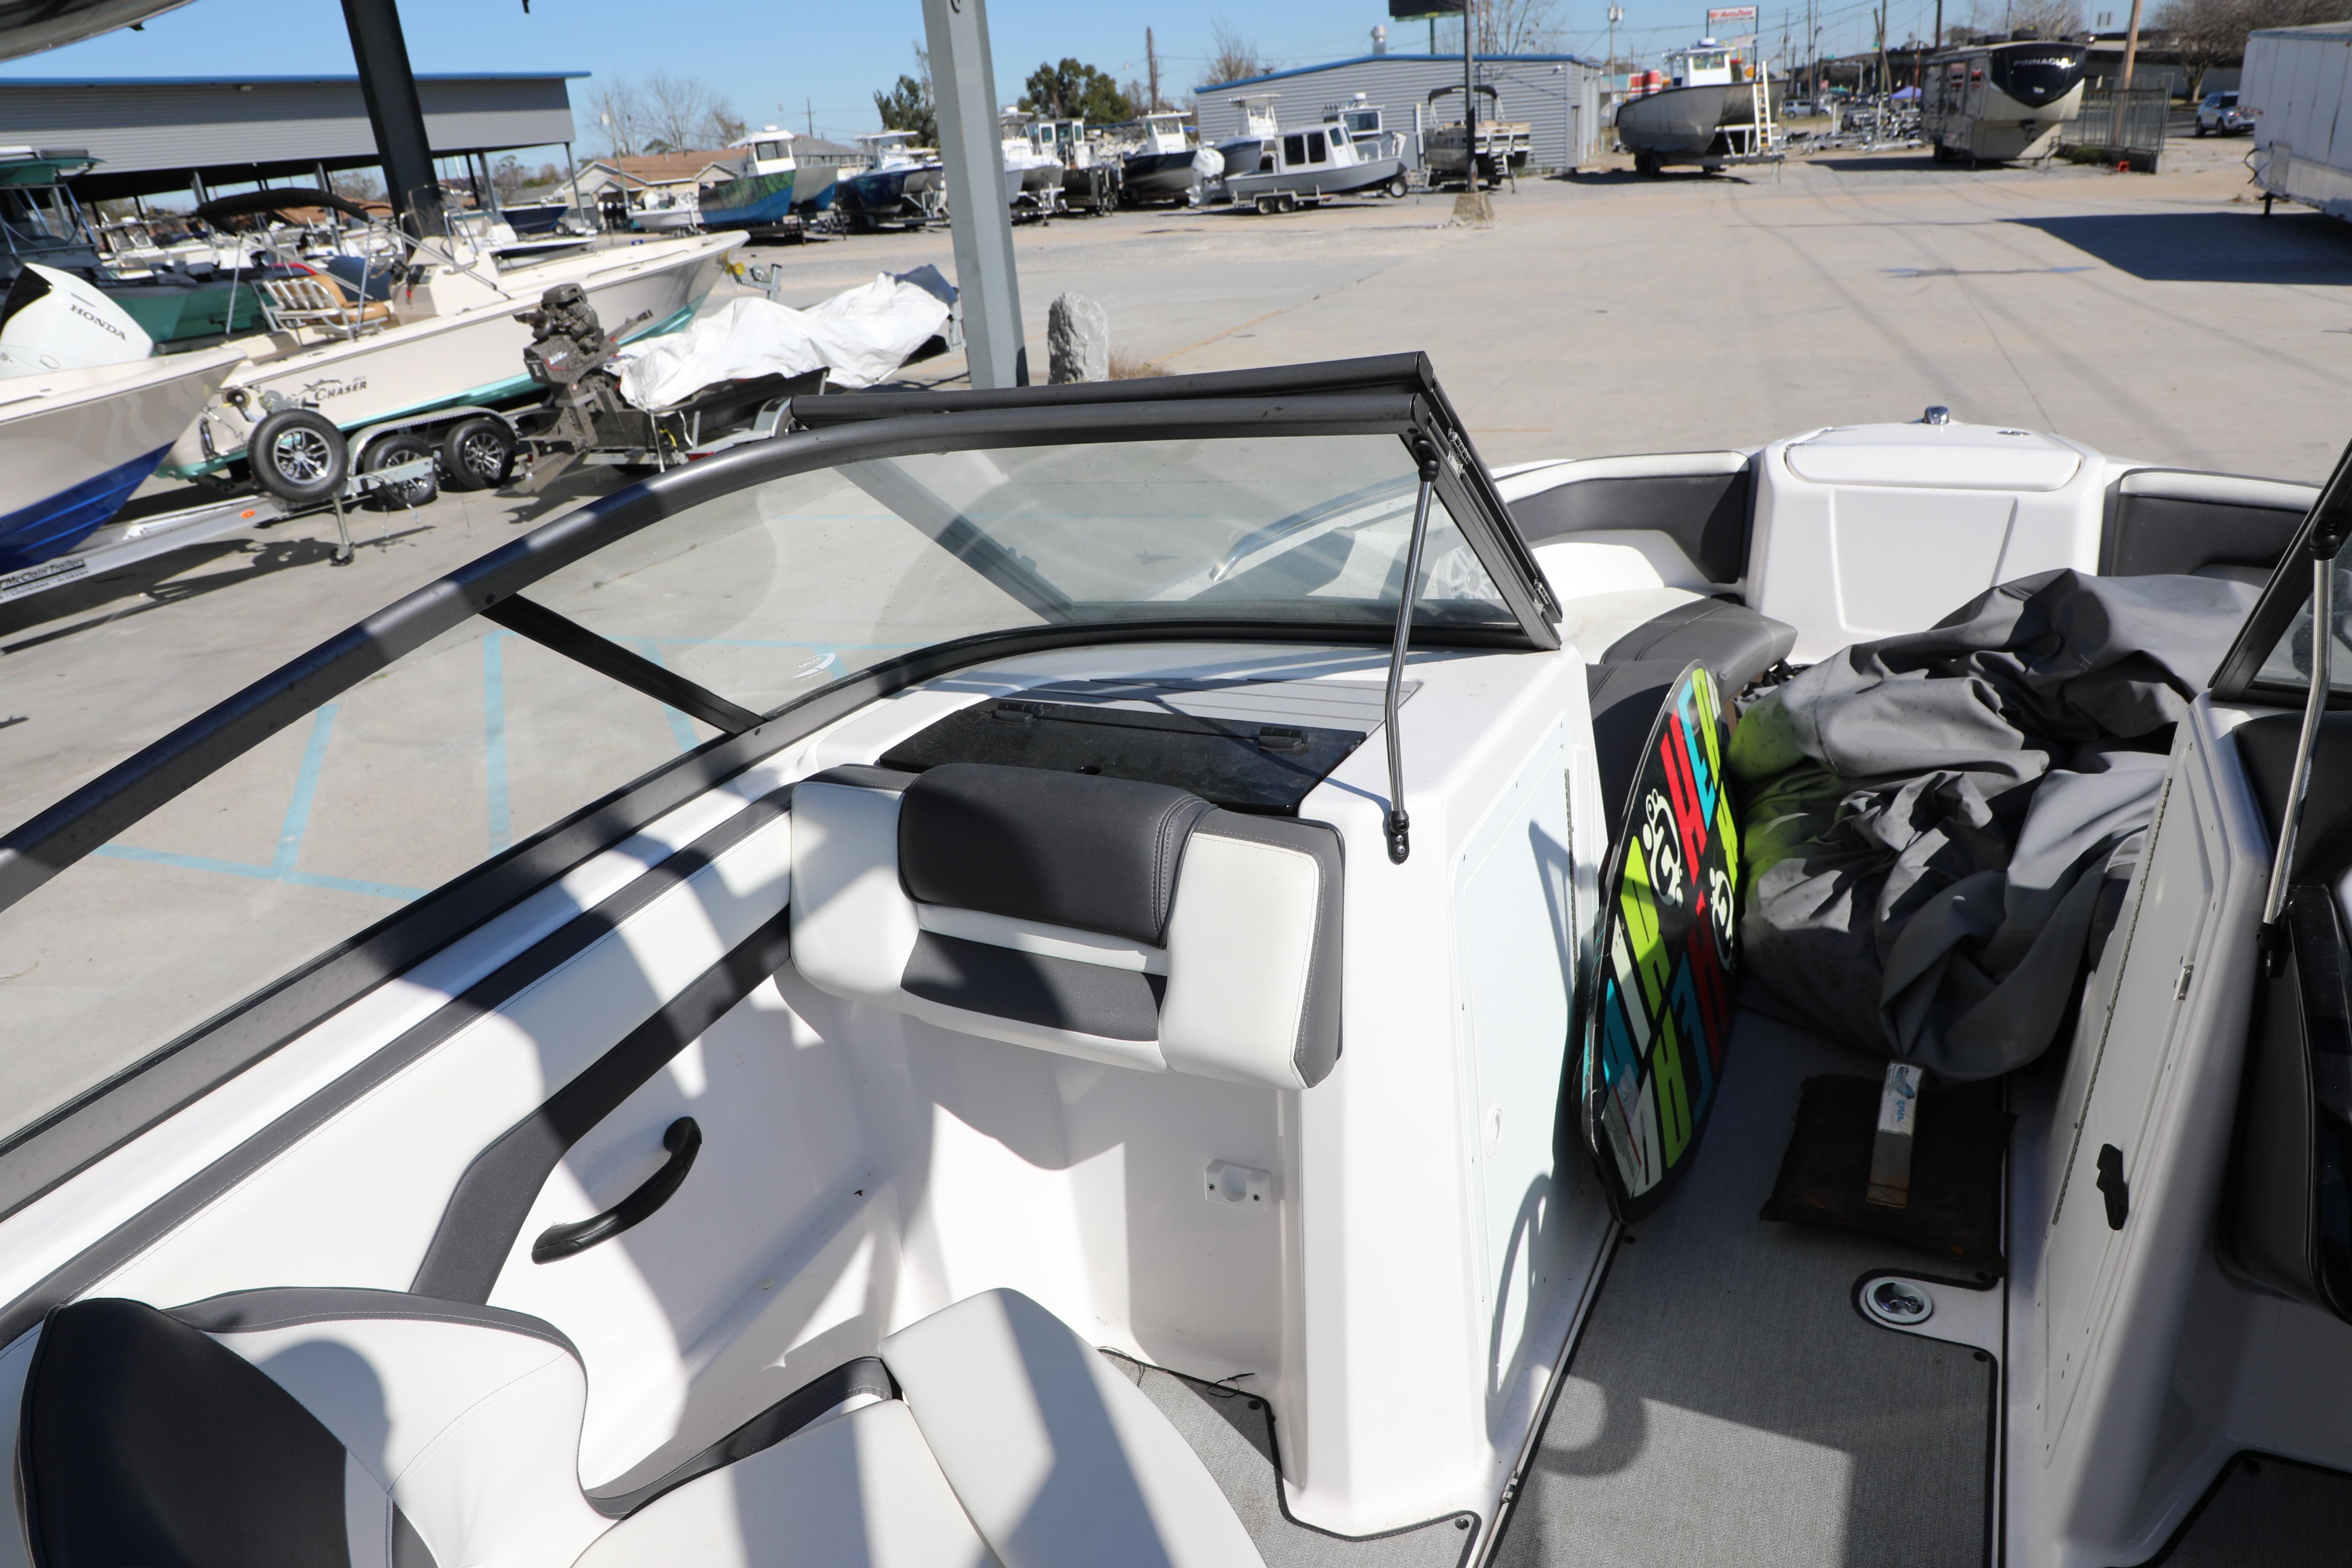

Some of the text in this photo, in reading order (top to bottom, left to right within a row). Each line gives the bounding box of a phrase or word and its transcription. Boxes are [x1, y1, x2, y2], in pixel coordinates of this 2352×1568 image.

[2013, 57, 2069, 68] PINNACL
[69, 304, 126, 340] HONDA
[6, 568, 46, 586] McClain
[50, 558, 84, 573] Trailers
